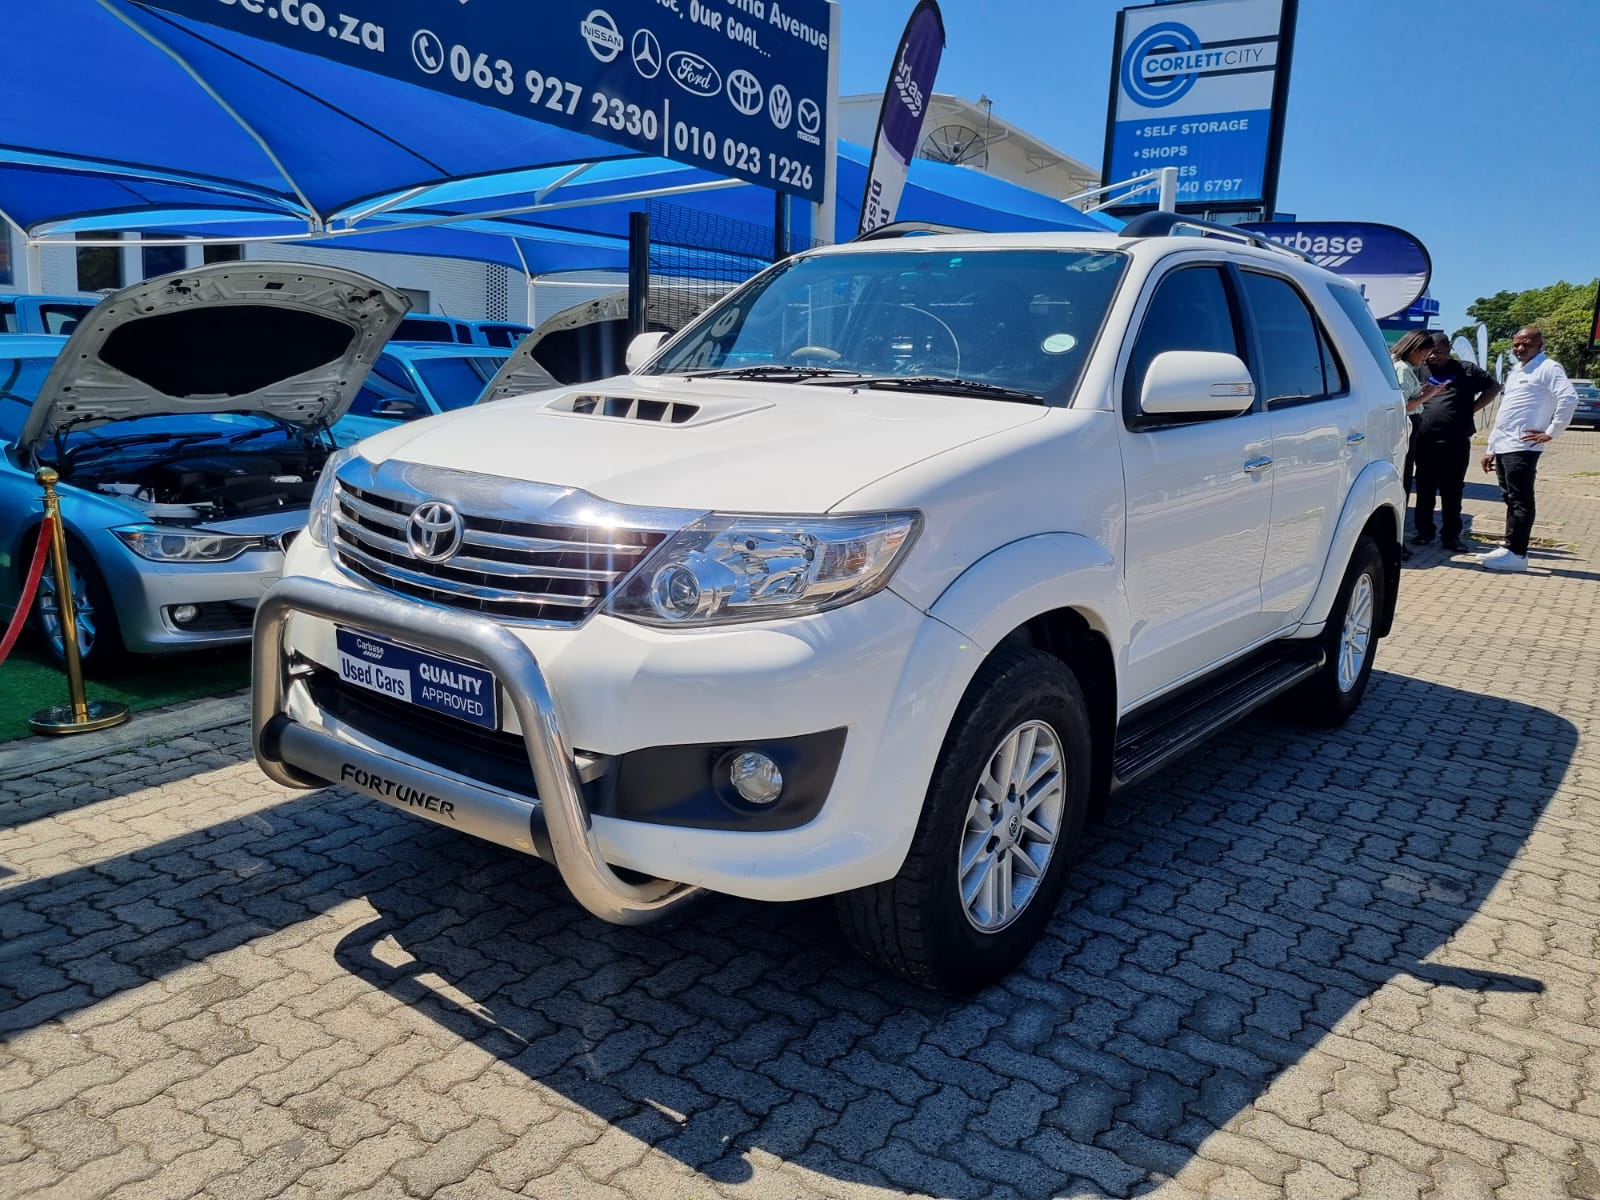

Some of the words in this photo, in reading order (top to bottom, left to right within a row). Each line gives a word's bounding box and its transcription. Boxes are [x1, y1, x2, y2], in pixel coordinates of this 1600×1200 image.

[583, 24, 621, 47] NISSAN
[769, 2, 828, 50] Avenue
[677, 57, 712, 89] Ford
[450, 44, 514, 96] 063
[525, 70, 583, 115] 927
[591, 92, 658, 140] 2330
[674, 121, 716, 160] 010
[723, 138, 760, 174] 023
[768, 153, 813, 190] 1226
[1143, 124, 1177, 137] SELF
[1181, 119, 1249, 135] STORAGE
[1141, 146, 1188, 159] SHOPS
[1204, 179, 1242, 192] 6797
[356, 638, 385, 655] Carbase
[342, 657, 372, 685] Used
[376, 668, 405, 696] Cars
[419, 663, 482, 695] QUALITY
[422, 686, 484, 716] APPROVED
[340, 763, 456, 820] FORTUNER
